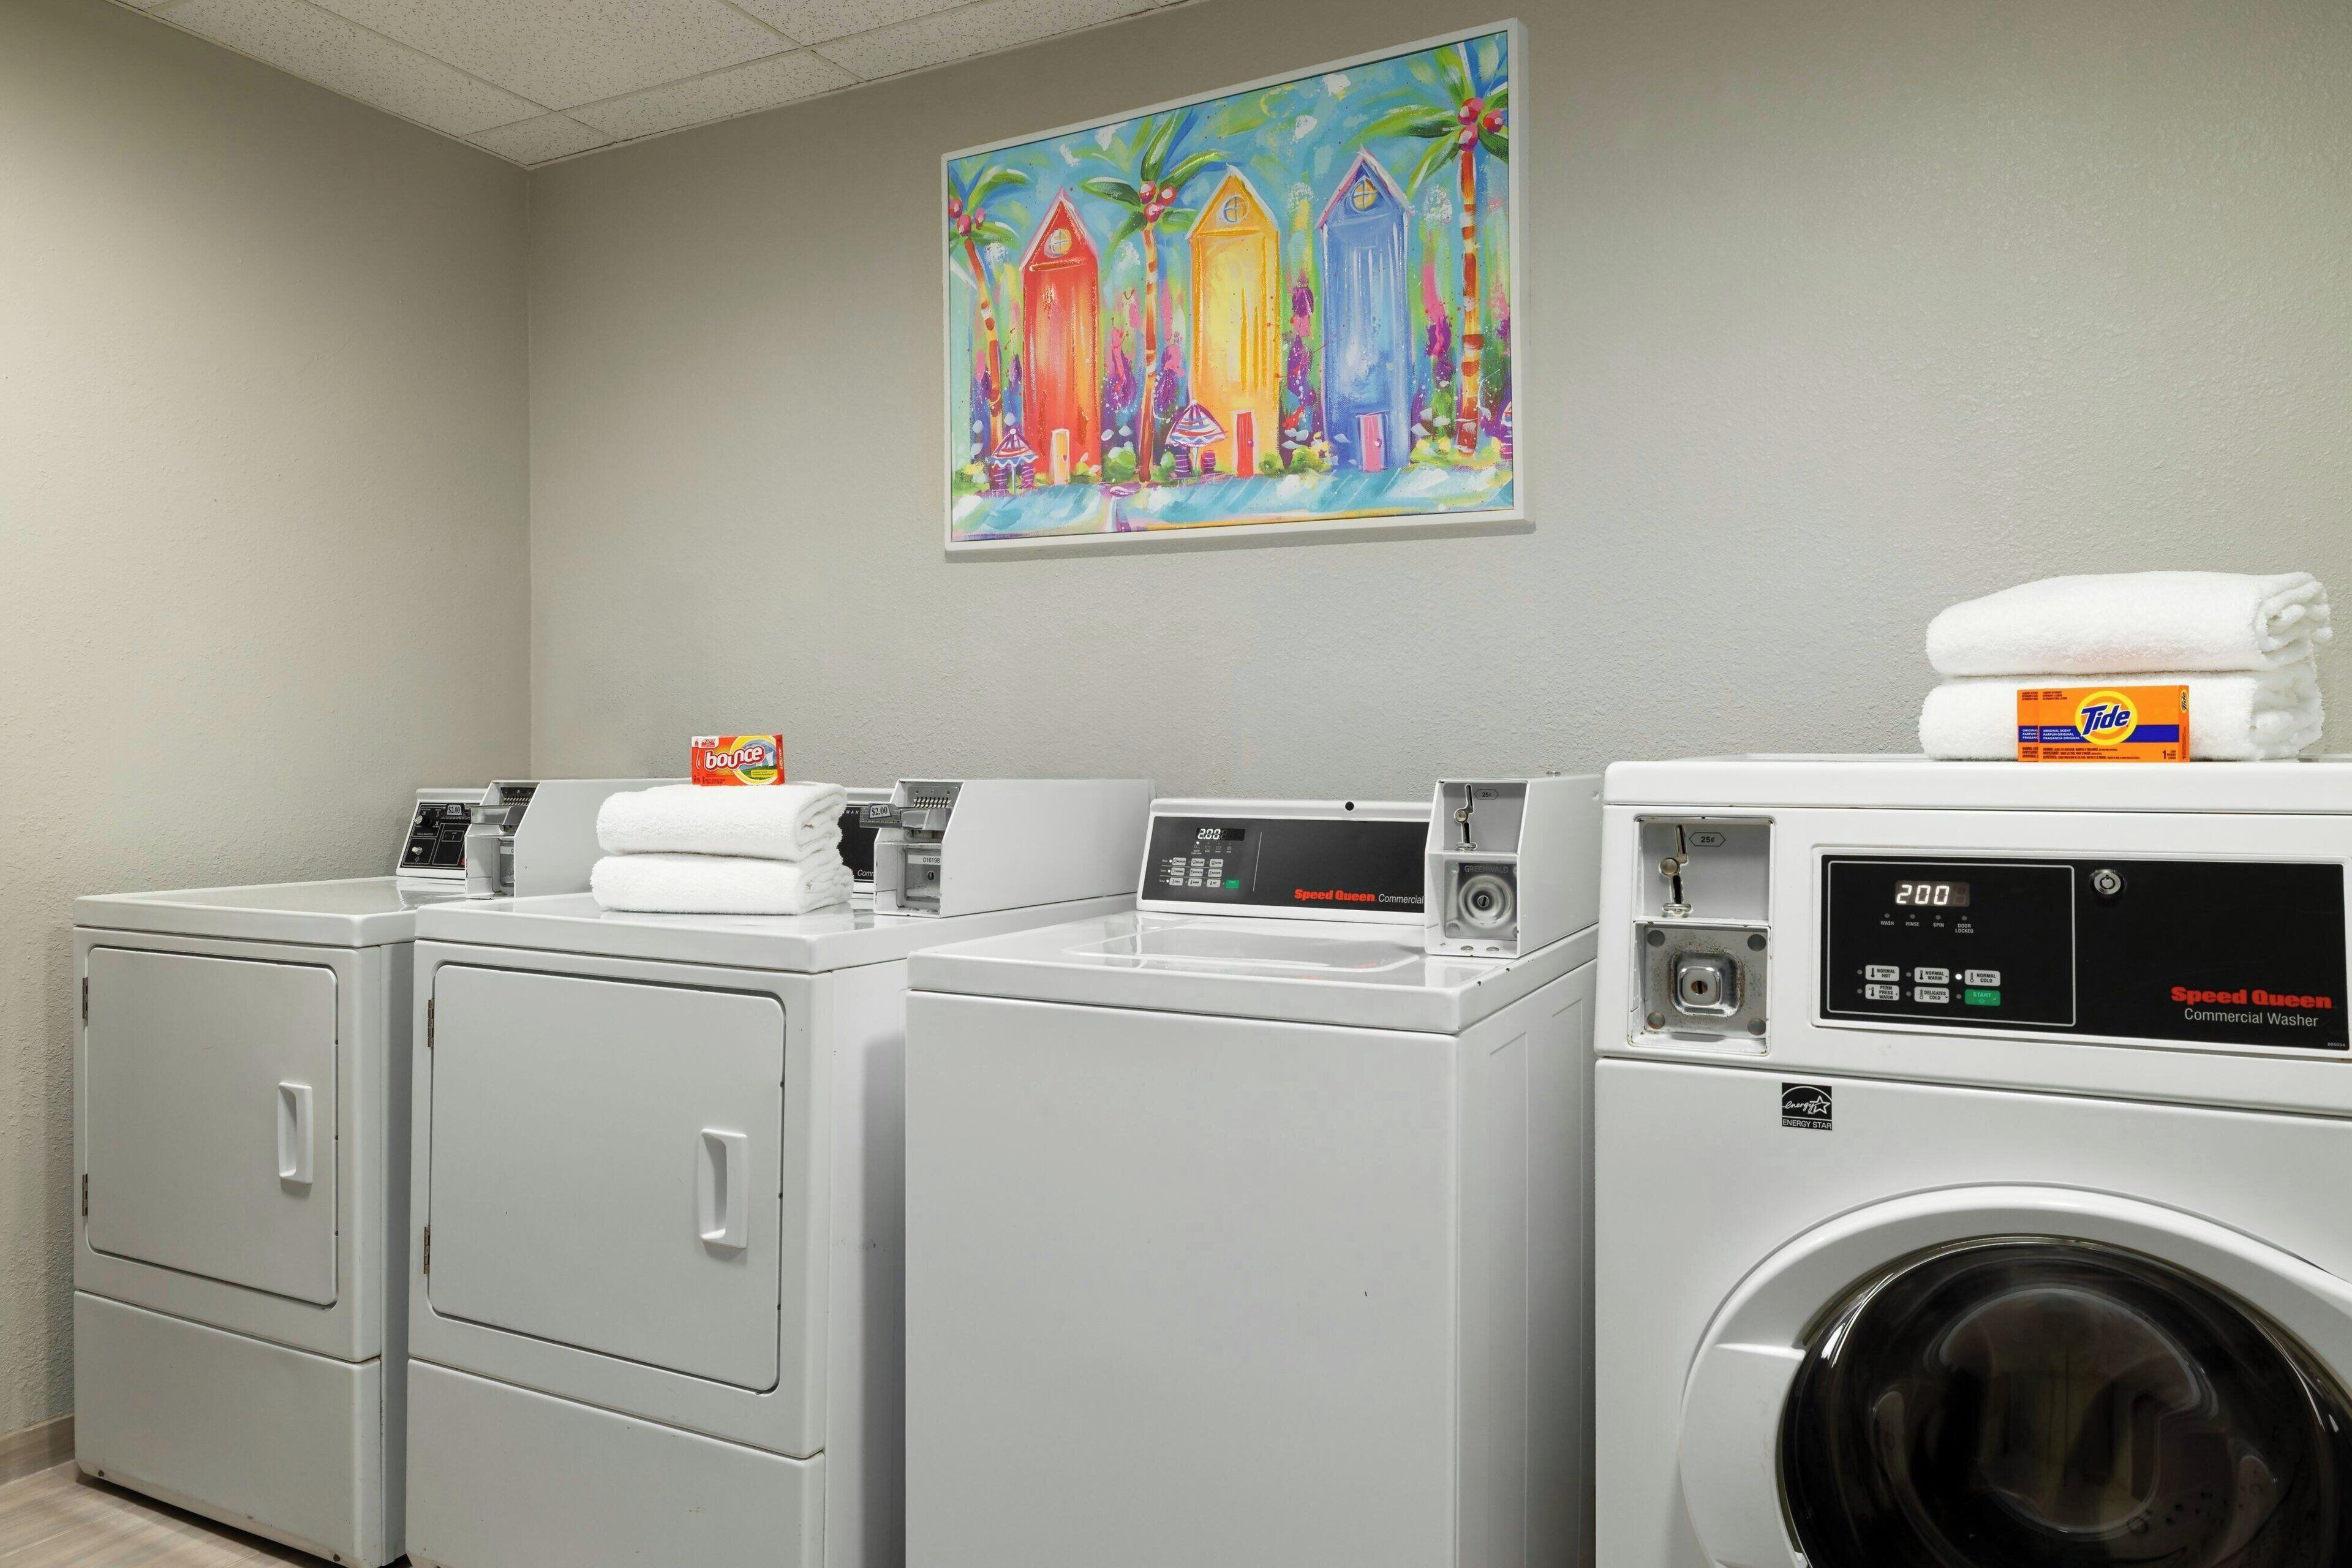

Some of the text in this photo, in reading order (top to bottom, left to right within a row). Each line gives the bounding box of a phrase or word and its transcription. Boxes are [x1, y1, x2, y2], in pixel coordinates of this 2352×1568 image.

[2080, 704, 2131, 736] Tide
[705, 746, 764, 771] bounce
[2162, 750, 2166, 760] 1
[871, 806, 888, 816] $2.00
[1464, 865, 1509, 873] GREENWALD
[1294, 888, 1424, 904] Speed Queen Commercial
[1896, 884, 1950, 905] 200
[2171, 986, 2332, 1009] Speed Queen
[2184, 1008, 2319, 1027] Commercial Washer
[1784, 1101, 1816, 1114] energy
[1782, 1118, 1811, 1128] ENERGY
